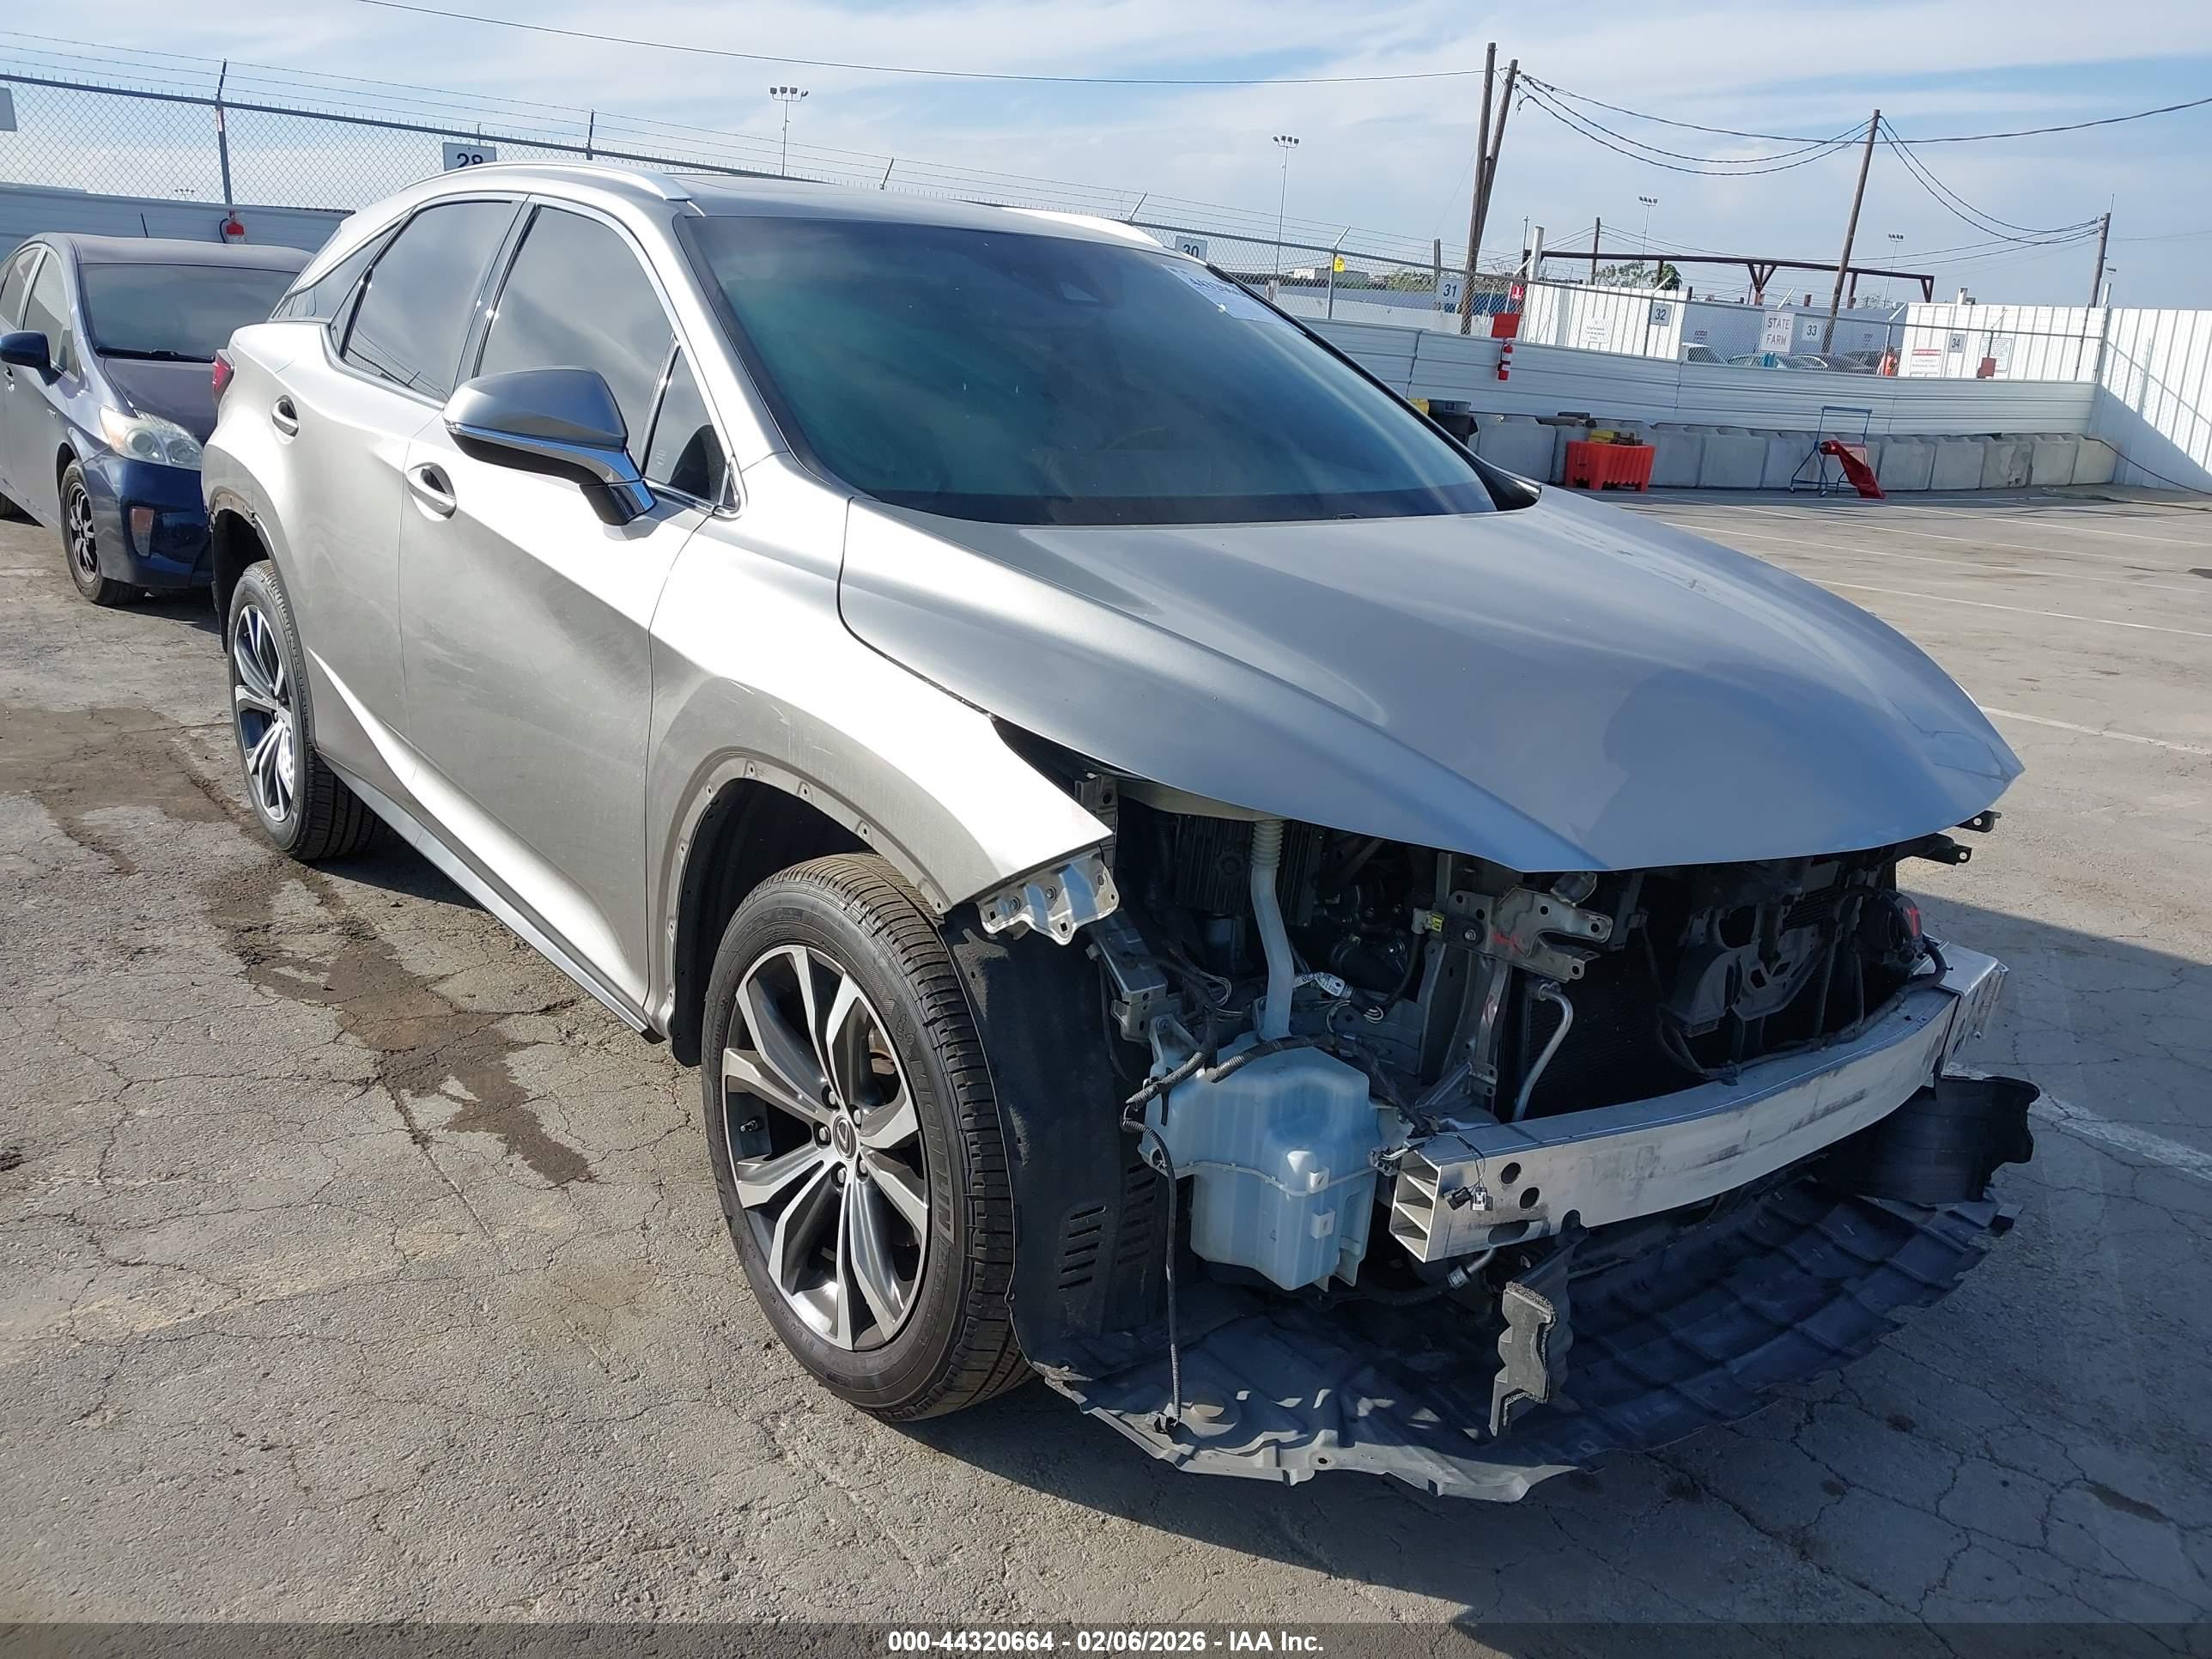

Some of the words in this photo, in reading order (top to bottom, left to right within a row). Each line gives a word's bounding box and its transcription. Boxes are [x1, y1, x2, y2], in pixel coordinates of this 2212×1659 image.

[1443, 284, 1457, 297] 31
[1655, 308, 1667, 320] 32
[1767, 318, 1790, 330] STATE
[1807, 325, 1818, 337] 33
[1765, 334, 1787, 345] FARM
[1951, 339, 1961, 348] 34
